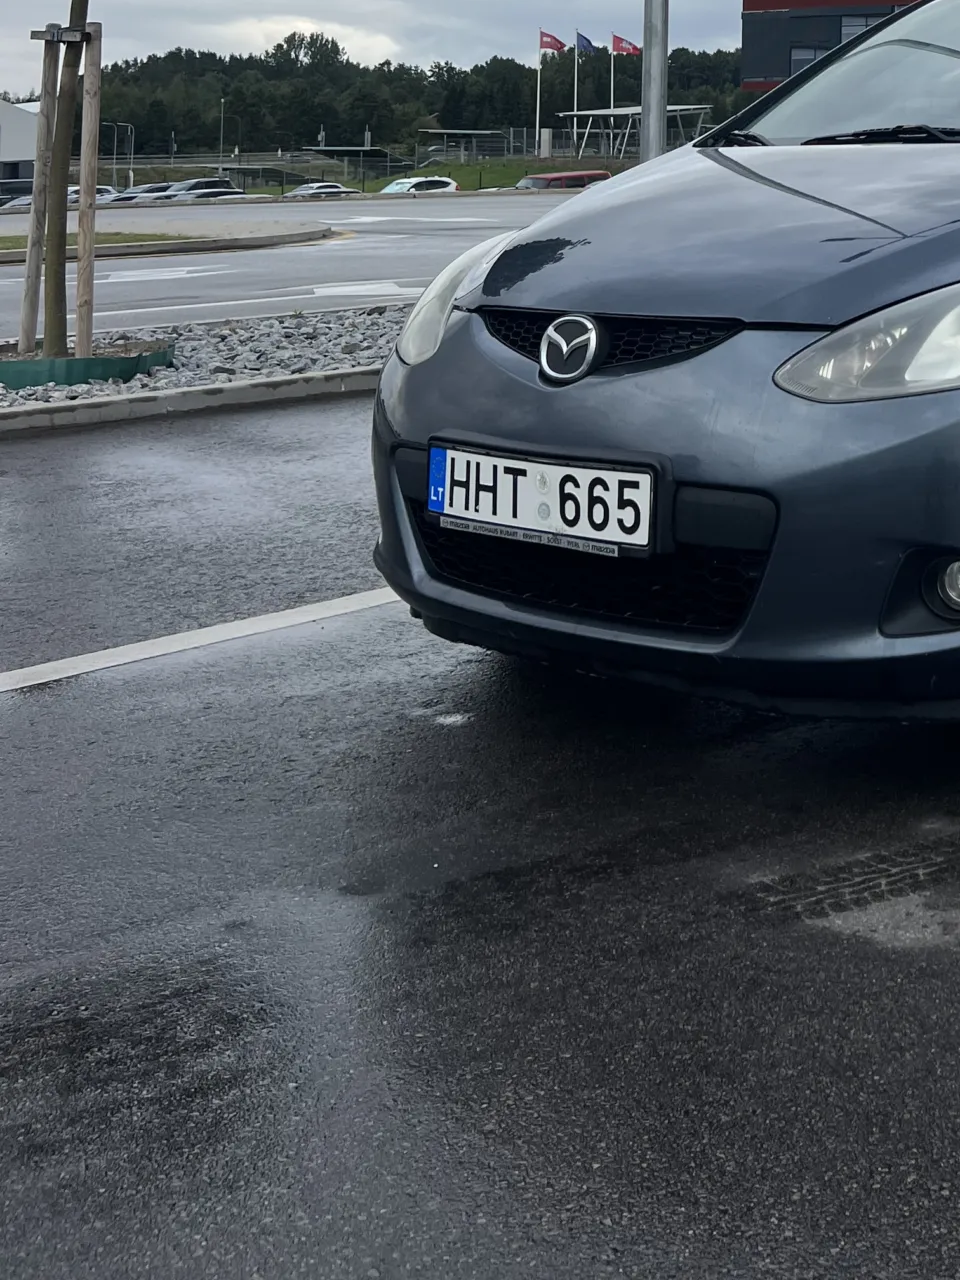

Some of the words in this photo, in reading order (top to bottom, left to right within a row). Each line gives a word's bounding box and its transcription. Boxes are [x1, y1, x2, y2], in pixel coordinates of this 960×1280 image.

[431, 485, 444, 502] LT
[449, 456, 528, 520] HHT
[558, 473, 641, 535] 665
